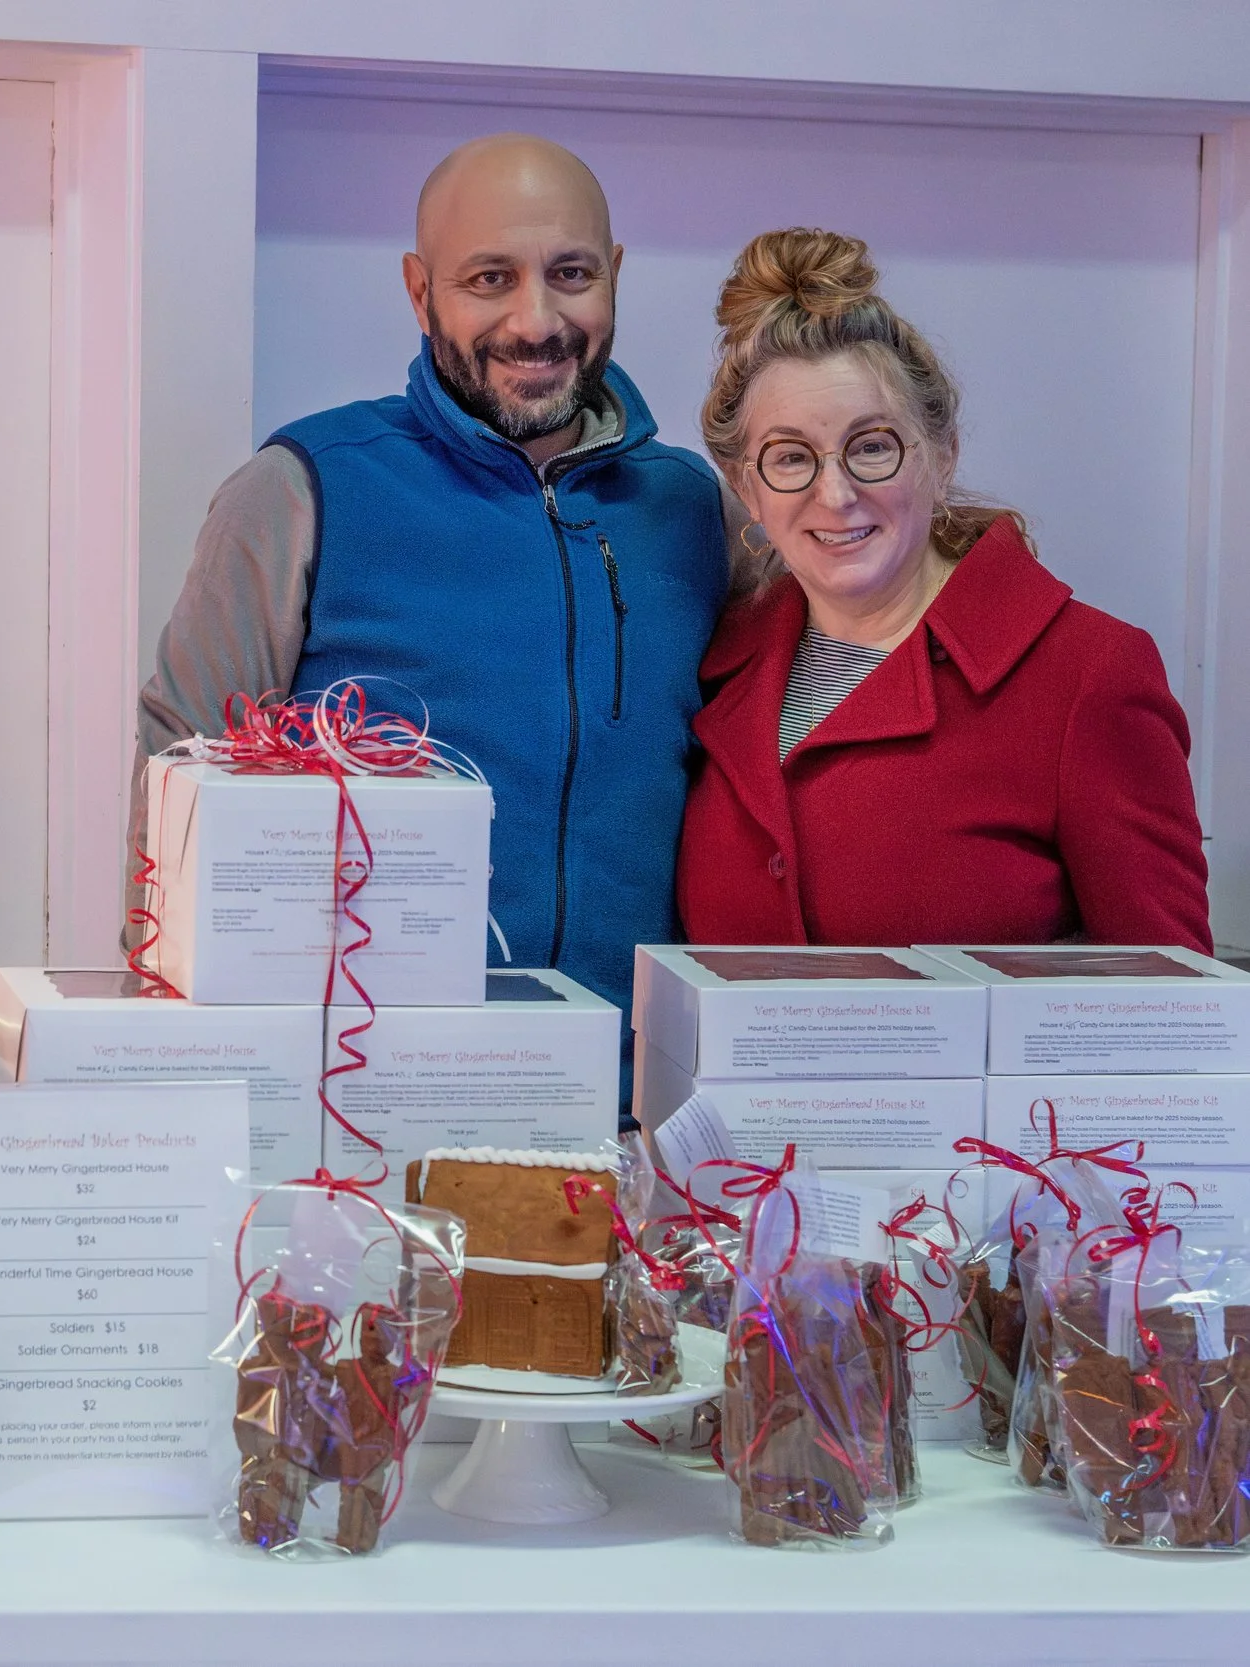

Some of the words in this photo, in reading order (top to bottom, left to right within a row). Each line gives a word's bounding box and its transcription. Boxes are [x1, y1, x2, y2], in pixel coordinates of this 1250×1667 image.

[262, 829, 286, 842] Very
[290, 829, 323, 842] Merry
[390, 828, 423, 842] House
[754, 1005, 778, 1018] Very
[782, 1005, 814, 1018] Merry
[817, 1003, 878, 1018] Gingerbread
[880, 1004, 912, 1017] House
[915, 1004, 931, 1016] Kit
[1046, 1002, 1069, 1015] Very
[1073, 1002, 1104, 1015] Merry
[1108, 1001, 1169, 1015] Gingerbread
[1170, 1001, 1202, 1014] House
[1205, 1001, 1221, 1013] Kit
[94, 1046, 117, 1058] Very
[122, 1045, 153, 1058] Merry
[158, 1044, 221, 1058] Gingerbread
[224, 1044, 257, 1057] House
[391, 1051, 415, 1064] Very
[419, 1051, 451, 1064] Merry
[454, 1050, 517, 1064] Gingerbread
[519, 1050, 552, 1063] House
[749, 1098, 773, 1111] Very
[776, 1098, 809, 1111] Merry
[811, 1097, 873, 1111] Gingerbread
[875, 1097, 907, 1111] House
[910, 1098, 925, 1110] Kit
[1069, 1095, 1101, 1108] Merry
[1104, 1094, 1165, 1108] Gingerbread
[1167, 1094, 1200, 1107] House
[1203, 1095, 1219, 1106] Kit
[0, 1133, 85, 1151] Gingerbread
[90, 1133, 130, 1149] Baker
[135, 1132, 197, 1148] Products
[0, 1164, 25, 1175] Very
[28, 1164, 58, 1175] Merry
[61, 1163, 133, 1176] Gingerbread
[135, 1163, 169, 1173] House
[76, 1183, 95, 1195] $32
[1202, 1183, 1218, 1194] Kit
[21, 1215, 51, 1227] Merry
[54, 1214, 126, 1227] Gingerbread
[129, 1214, 162, 1224] House
[165, 1214, 179, 1224] Kit
[76, 1235, 96, 1246] $24
[44, 1268, 72, 1279] Time
[75, 1267, 154, 1281] Gingerbread
[157, 1266, 194, 1277] House
[77, 1288, 98, 1301] $60
[49, 1322, 95, 1334] Soldiers
[104, 1321, 126, 1334] $15
[17, 1345, 57, 1356] Soldier
[60, 1344, 128, 1356] Ornaments
[137, 1343, 159, 1356] $18
[76, 1377, 132, 1391] Snacking
[134, 1376, 183, 1388] Cookies
[82, 1399, 97, 1412] $2
